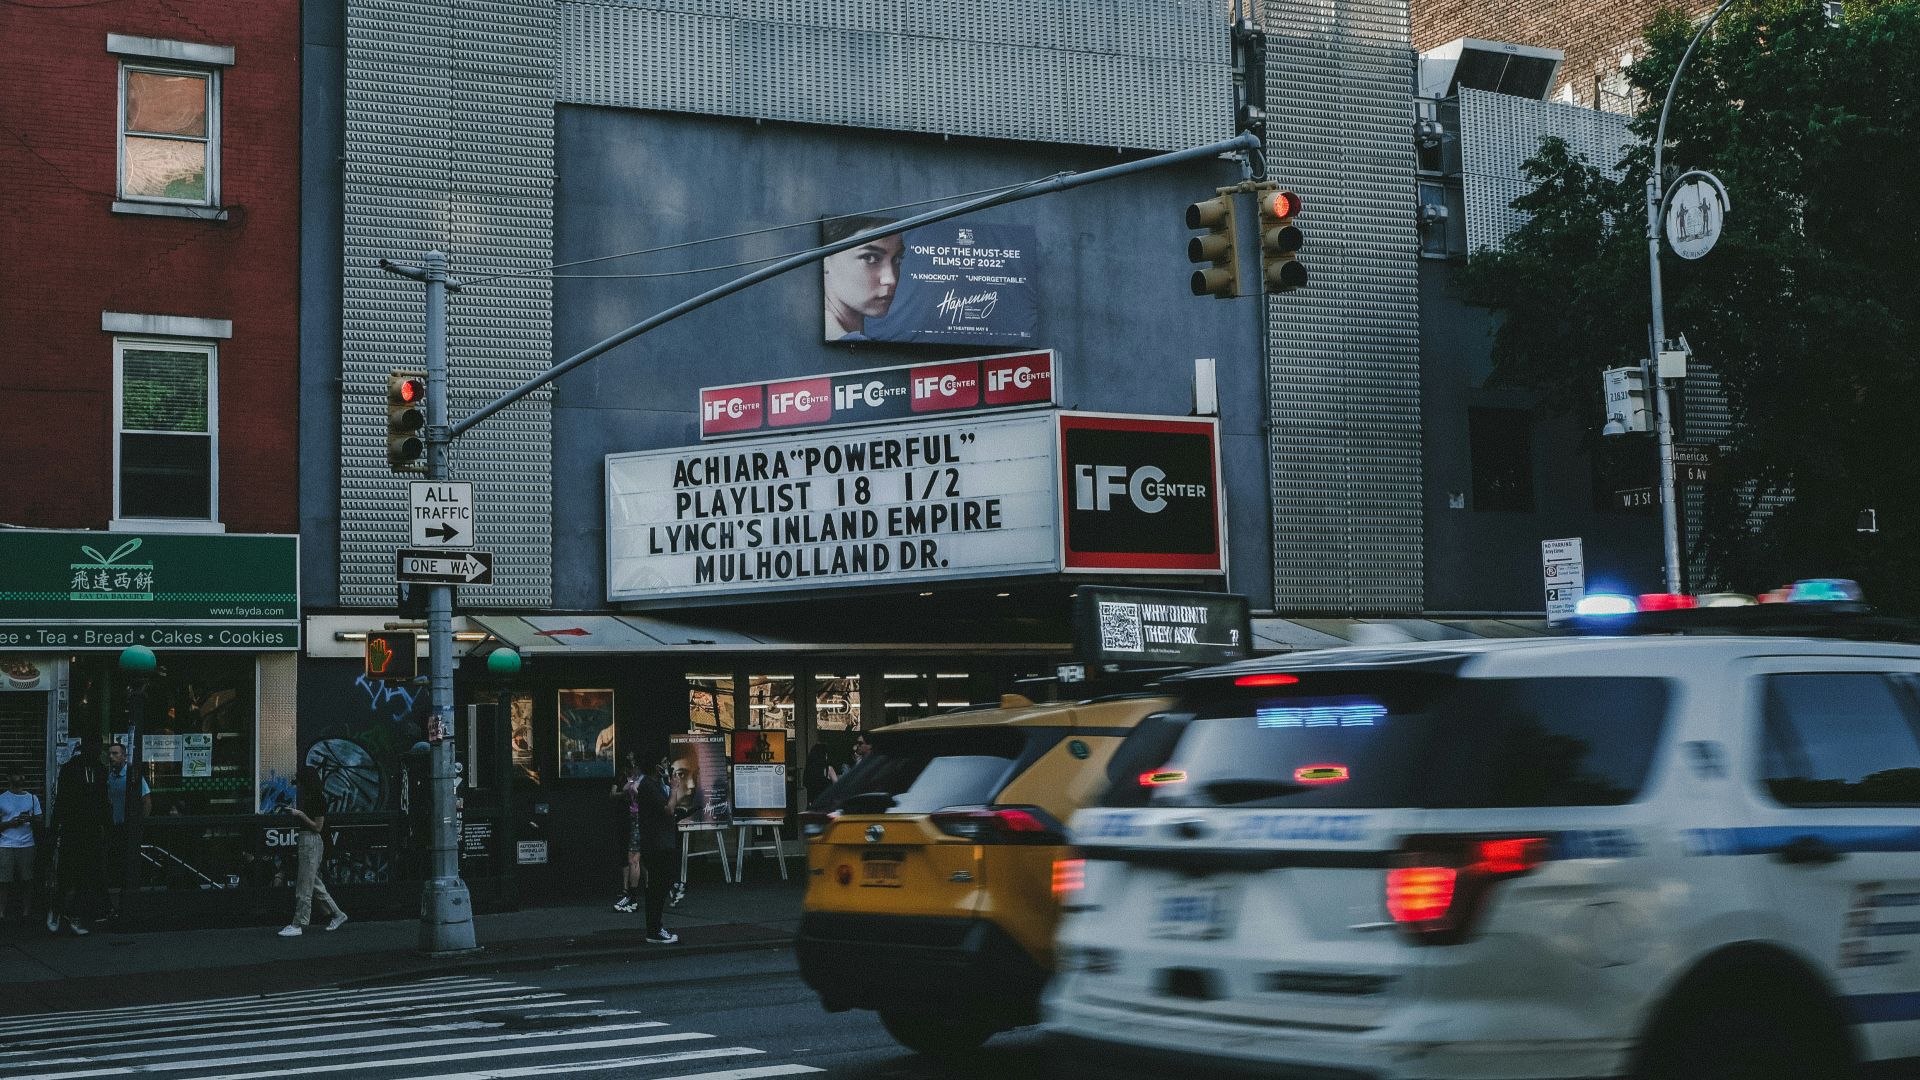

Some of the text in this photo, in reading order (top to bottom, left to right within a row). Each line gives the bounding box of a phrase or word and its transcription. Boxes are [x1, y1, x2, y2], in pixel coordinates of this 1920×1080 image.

[911, 246, 1021, 259] "ONE OF THE MUST-SEE
[933, 256, 961, 266] FILMS
[963, 258, 975, 267] OF
[936, 288, 998, 324] Happening
[1021, 371, 1050, 381] CENTER
[947, 379, 976, 389] CENTER
[873, 387, 907, 398] CENTER
[801, 395, 829, 404] CENTER
[734, 402, 760, 412] CENTER
[1675, 451, 1709, 462] Americas
[1688, 467, 1707, 480] 6 Av
[425, 487, 458, 502] ALL
[1145, 483, 1206, 498] CENTER
[676, 481, 811, 519] PLAYLIST
[1623, 491, 1651, 507] W 3 St
[414, 507, 469, 519] TRAFFIC
[650, 499, 1001, 554] LYNCH'S INLAND EMPIRE
[411, 559, 478, 574] ONE WAY
[696, 539, 948, 583] MULHOLLAND DR.
[71, 569, 154, 592] 飛達西餅
[1549, 590, 1556, 601] 2
[209, 606, 284, 617] www.fayda.com
[37, 630, 67, 644] Tea
[85, 630, 134, 644] Bread
[151, 630, 202, 644] Cakes
[219, 630, 284, 644] Cookies
[1143, 624, 1173, 643] THEY
